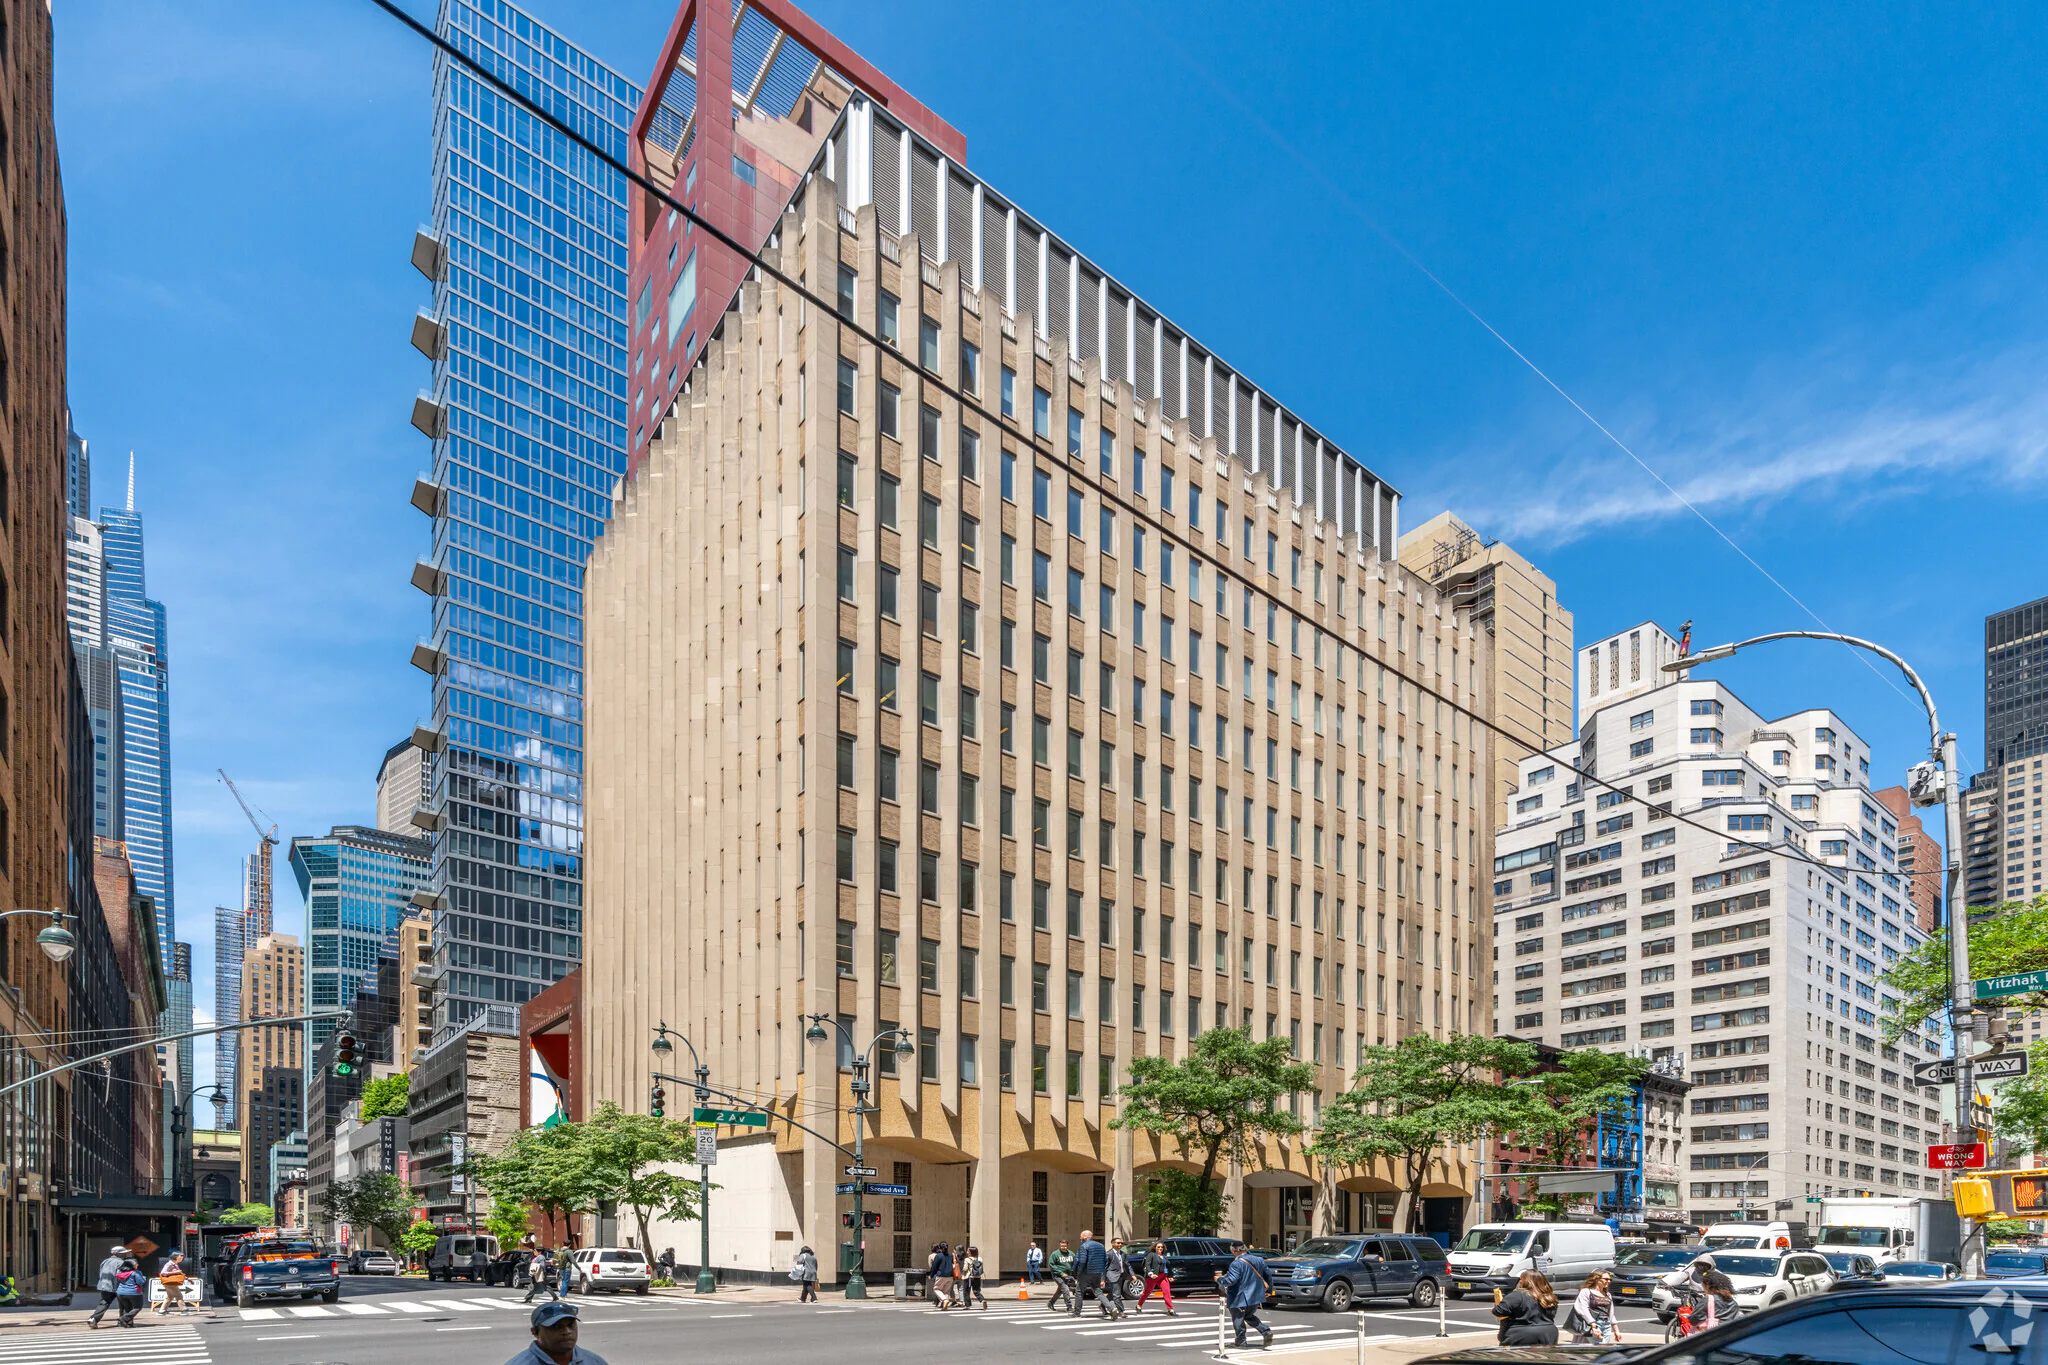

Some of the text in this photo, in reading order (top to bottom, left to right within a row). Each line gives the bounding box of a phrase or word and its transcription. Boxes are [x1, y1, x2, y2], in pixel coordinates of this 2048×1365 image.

[1986, 974, 2039, 990] Yitzhak
[1979, 1059, 2016, 1073] WAY
[716, 1112, 745, 1123] 2 Av
[700, 1136, 713, 1144] 20
[1937, 1152, 1975, 1161] WRONG
